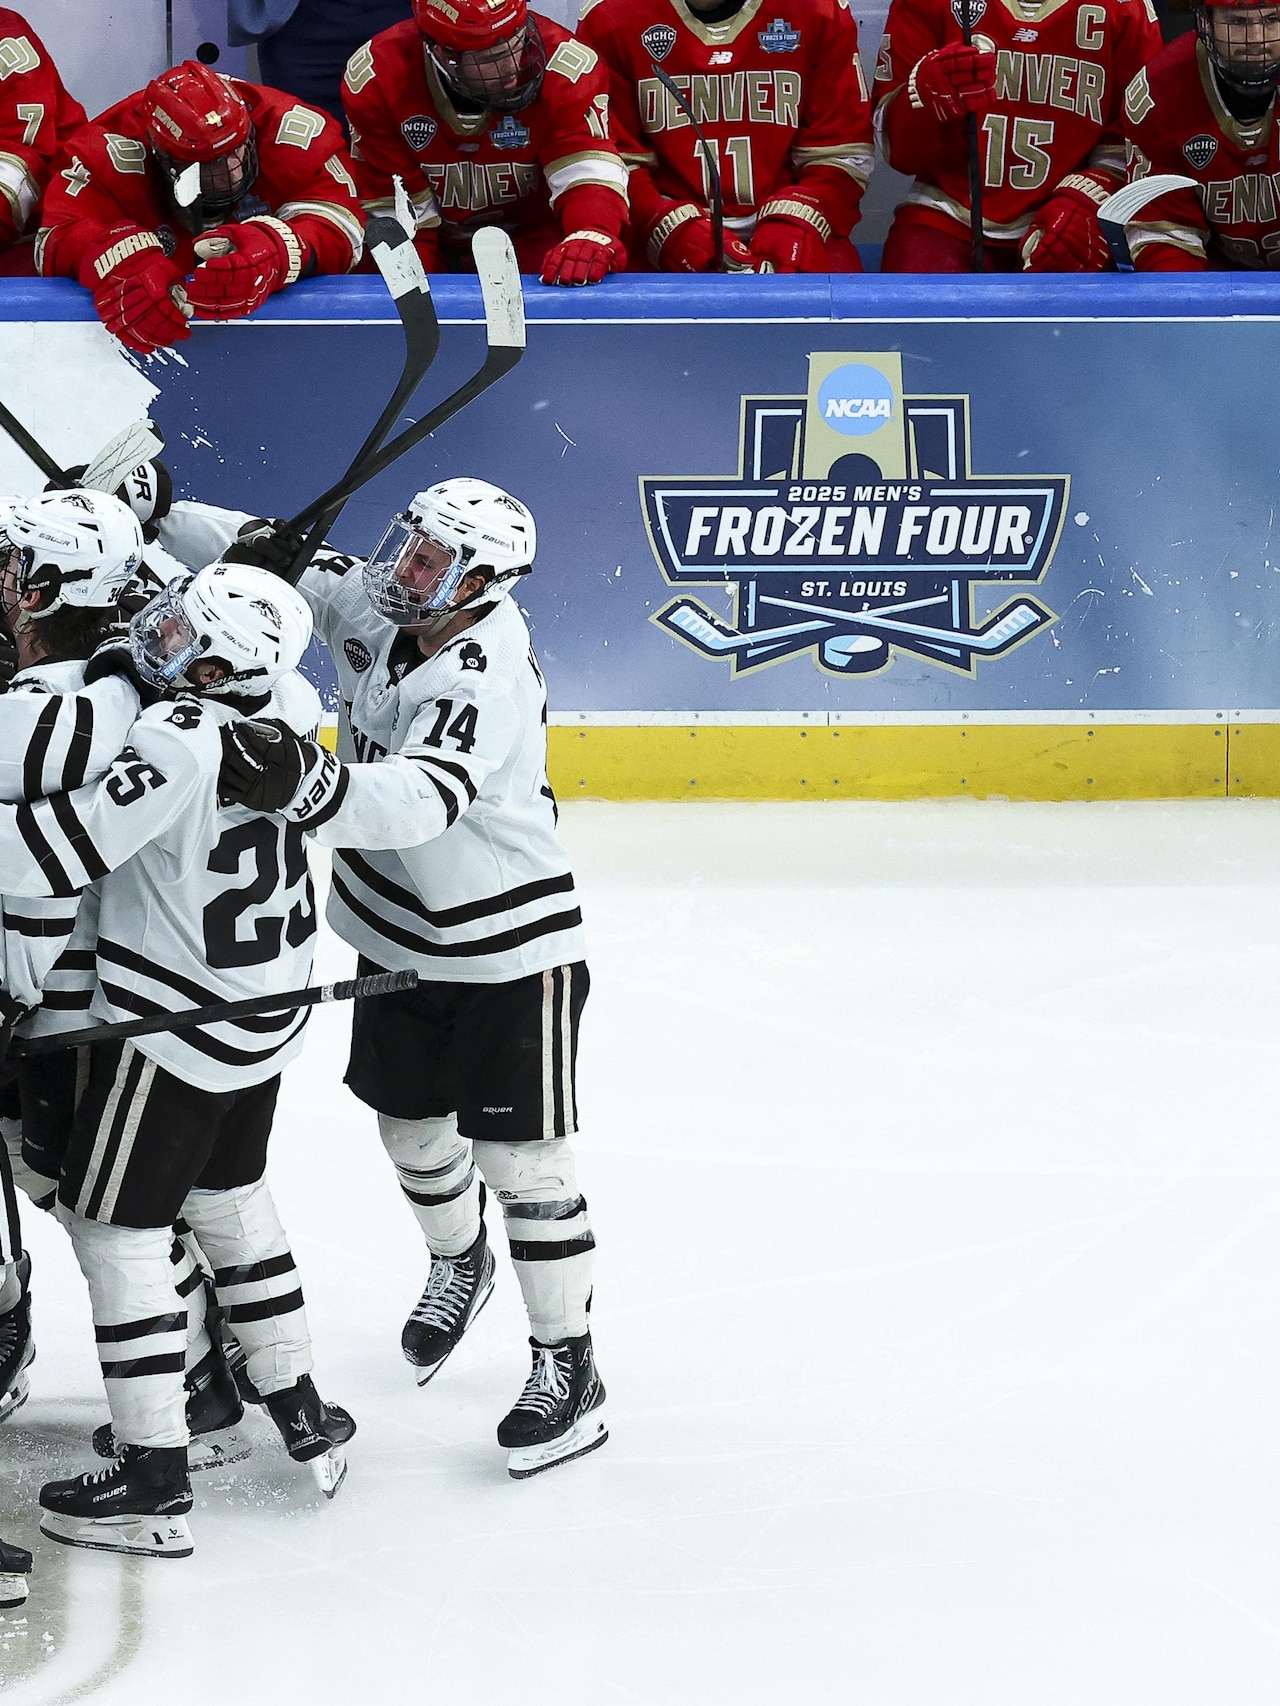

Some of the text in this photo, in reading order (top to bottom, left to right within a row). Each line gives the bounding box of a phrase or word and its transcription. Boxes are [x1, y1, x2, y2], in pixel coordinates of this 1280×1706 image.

[953, 1, 984, 11] NHC
[644, 30, 675, 42] NCHC
[1076, 4, 1106, 51] C
[638, 70, 802, 134] DENVER
[995, 50, 1106, 126] NVER
[17, 104, 44, 147] 7
[404, 121, 436, 134] NCHC
[981, 113, 1055, 190] 15
[1185, 140, 1217, 152] NCHC
[420, 161, 540, 211] ENVER
[93, 231, 164, 279] WARRI
[824, 398, 893, 419] NCAA
[129, 465, 152, 502] ER
[787, 486, 922, 502] 2025 MEN'S
[481, 534, 511, 549] BAUER
[684, 505, 887, 556] FROZEN
[432, 568, 460, 607] BAUER
[801, 581, 907, 597] ST. LOUIS
[164, 647, 197, 677] BAUER
[345, 642, 372, 663] NCHC
[423, 699, 479, 754] 14
[292, 745, 341, 819] AUER
[482, 1106, 514, 1115] BAUER
[92, 1484, 128, 1503] BAUER
